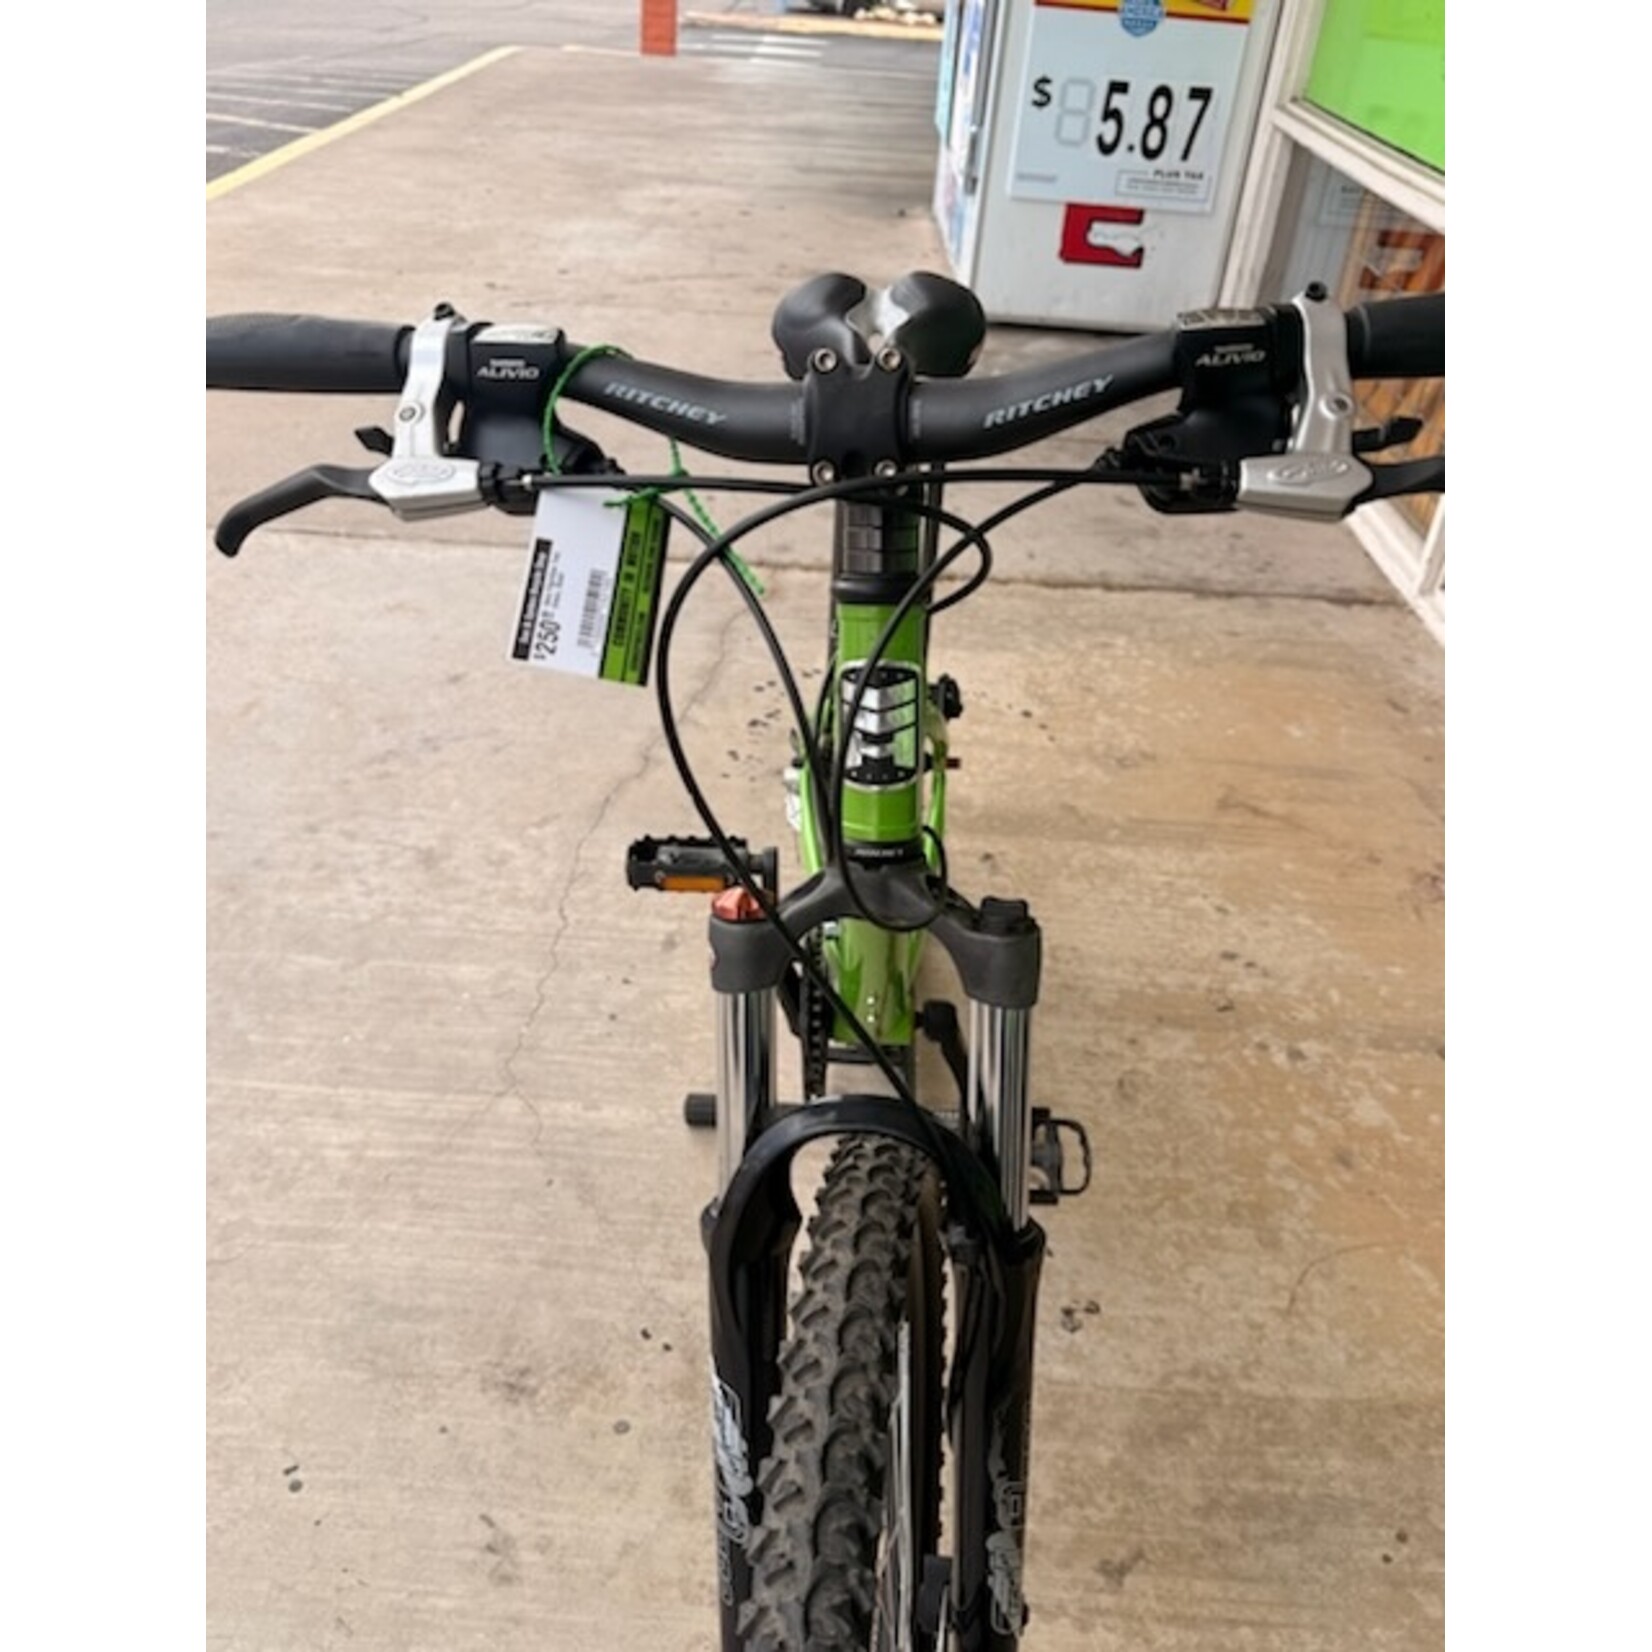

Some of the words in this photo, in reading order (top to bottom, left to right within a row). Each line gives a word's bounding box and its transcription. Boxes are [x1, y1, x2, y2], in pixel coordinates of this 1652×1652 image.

[1031, 76, 1052, 109] $
[1097, 81, 1213, 162] 5.87
[476, 365, 540, 380] ALIVIO
[1194, 349, 1266, 367] ALIVIO
[604, 381, 727, 425] RITCHEY
[984, 375, 1113, 429] RITCHEY
